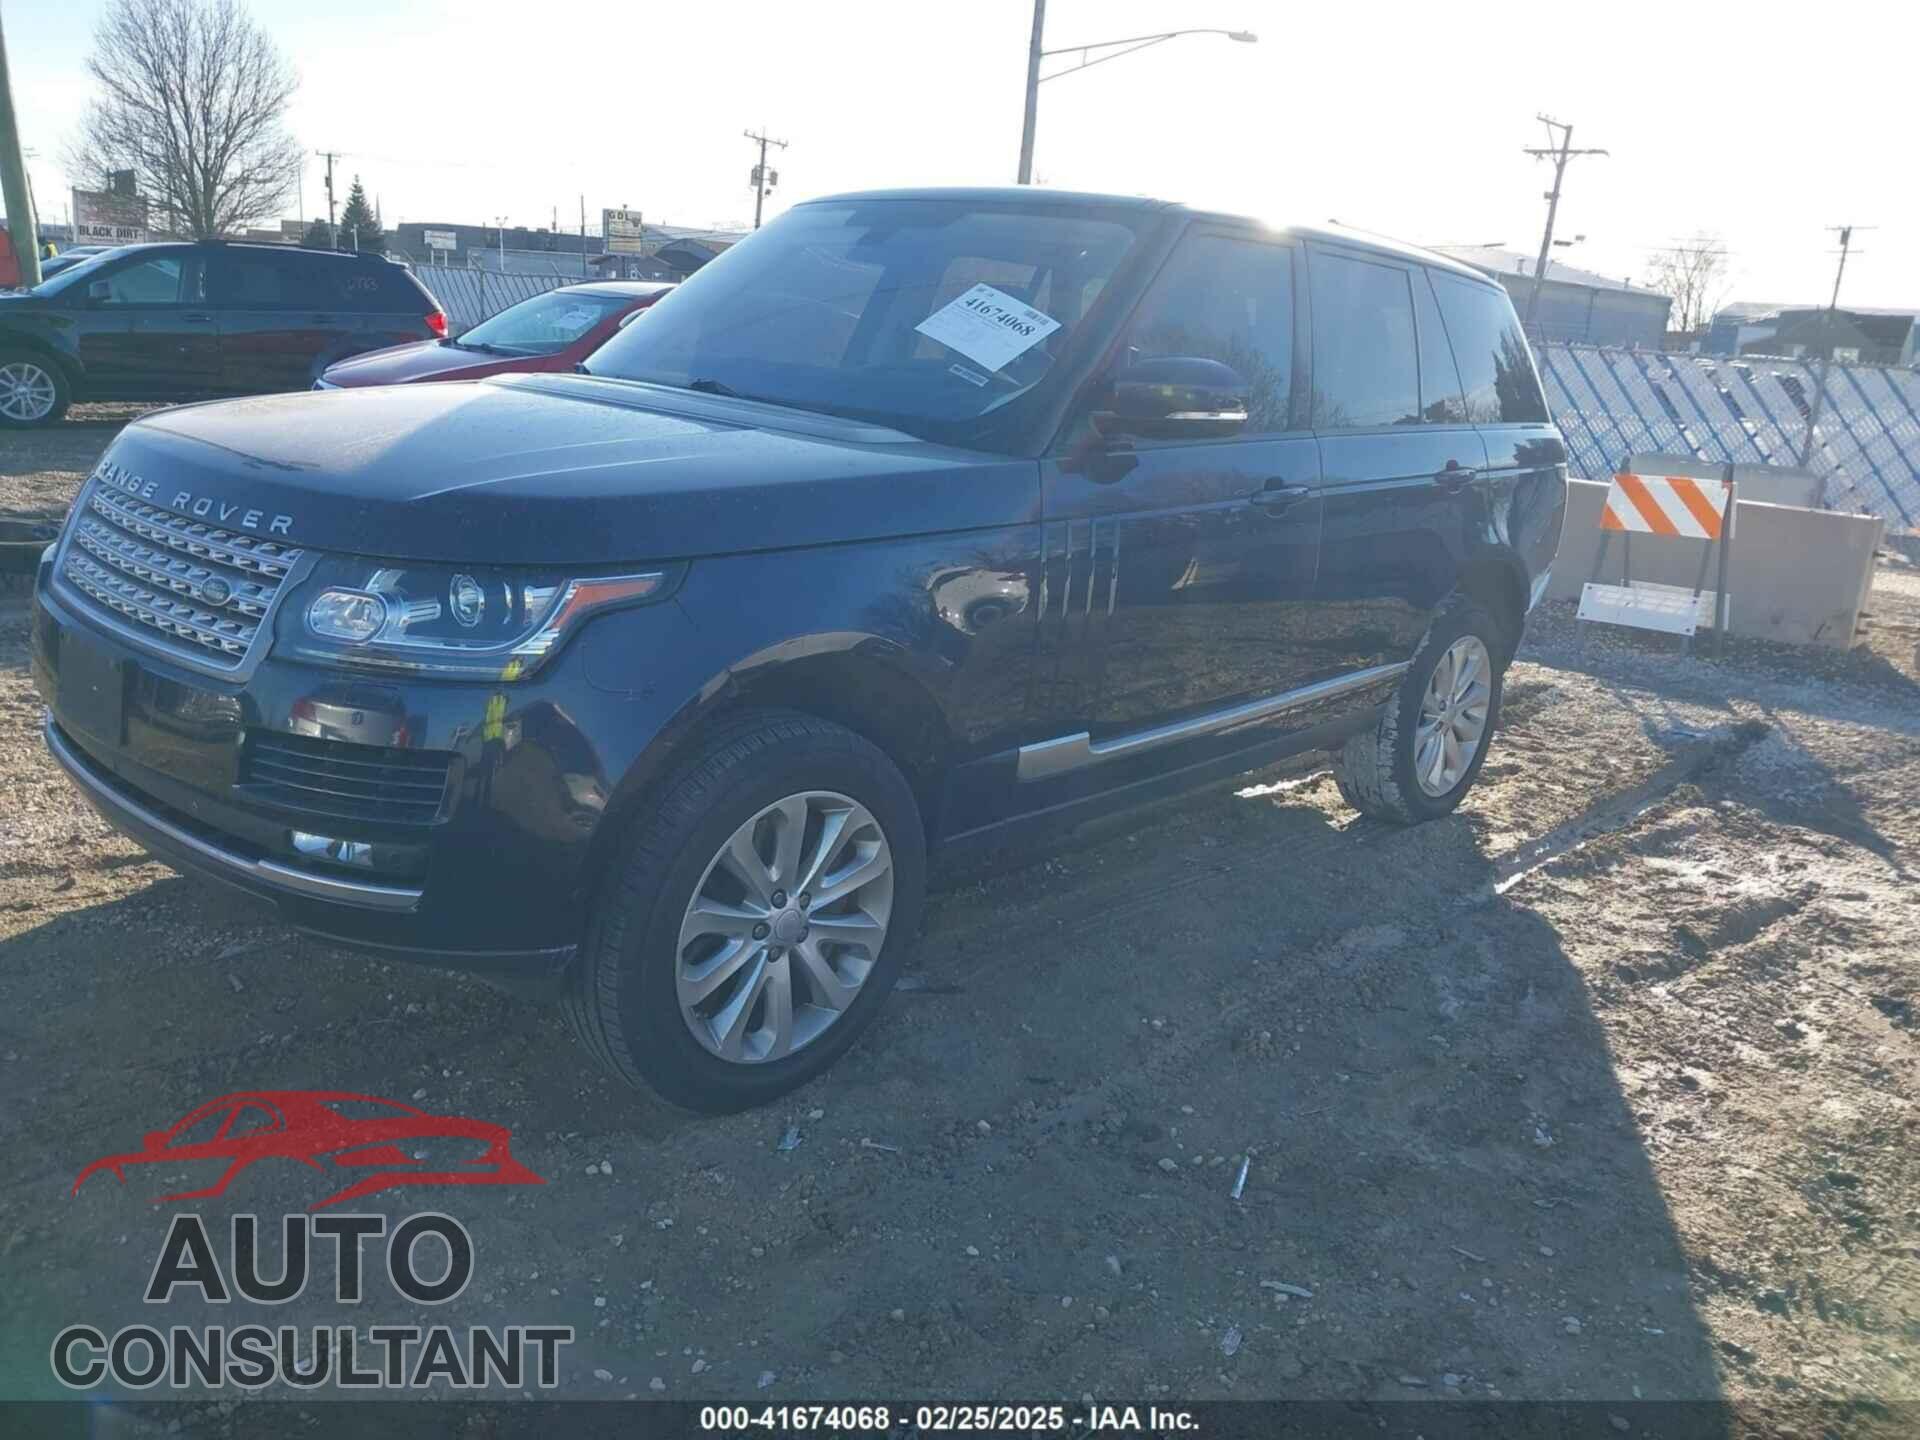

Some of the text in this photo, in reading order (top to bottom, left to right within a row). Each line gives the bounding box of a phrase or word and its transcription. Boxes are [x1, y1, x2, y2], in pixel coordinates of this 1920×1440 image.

[80, 225, 112, 238] BLACK
[965, 298, 1036, 336] 41674068
[99, 460, 294, 535] RANGE ROVER
